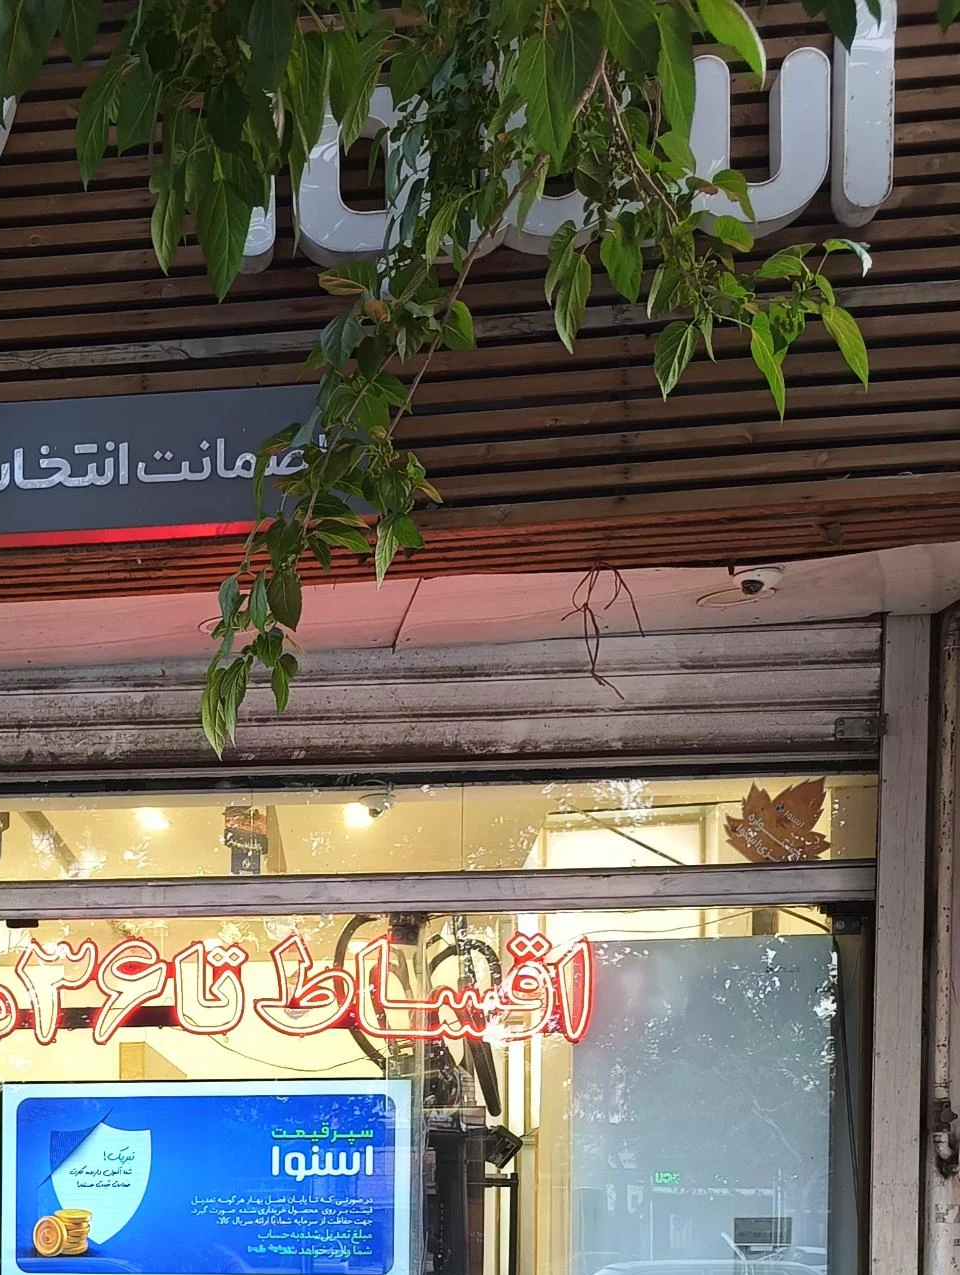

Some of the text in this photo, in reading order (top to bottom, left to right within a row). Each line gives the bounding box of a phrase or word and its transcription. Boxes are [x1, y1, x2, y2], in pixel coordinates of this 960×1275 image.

[254, 931, 594, 1045] اقساط
[271, 1121, 374, 1145] سپر قیمت
[271, 1145, 374, 1182] اسنوا
[336, 1197, 363, 1206] صورتی
[288, 1206, 318, 1216] محصول
[258, 1229, 290, 1241] حساب
[320, 1229, 350, 1242] تعدیل
[351, 1229, 373, 1244] مبلغ
[353, 1245, 373, 1255] شما
